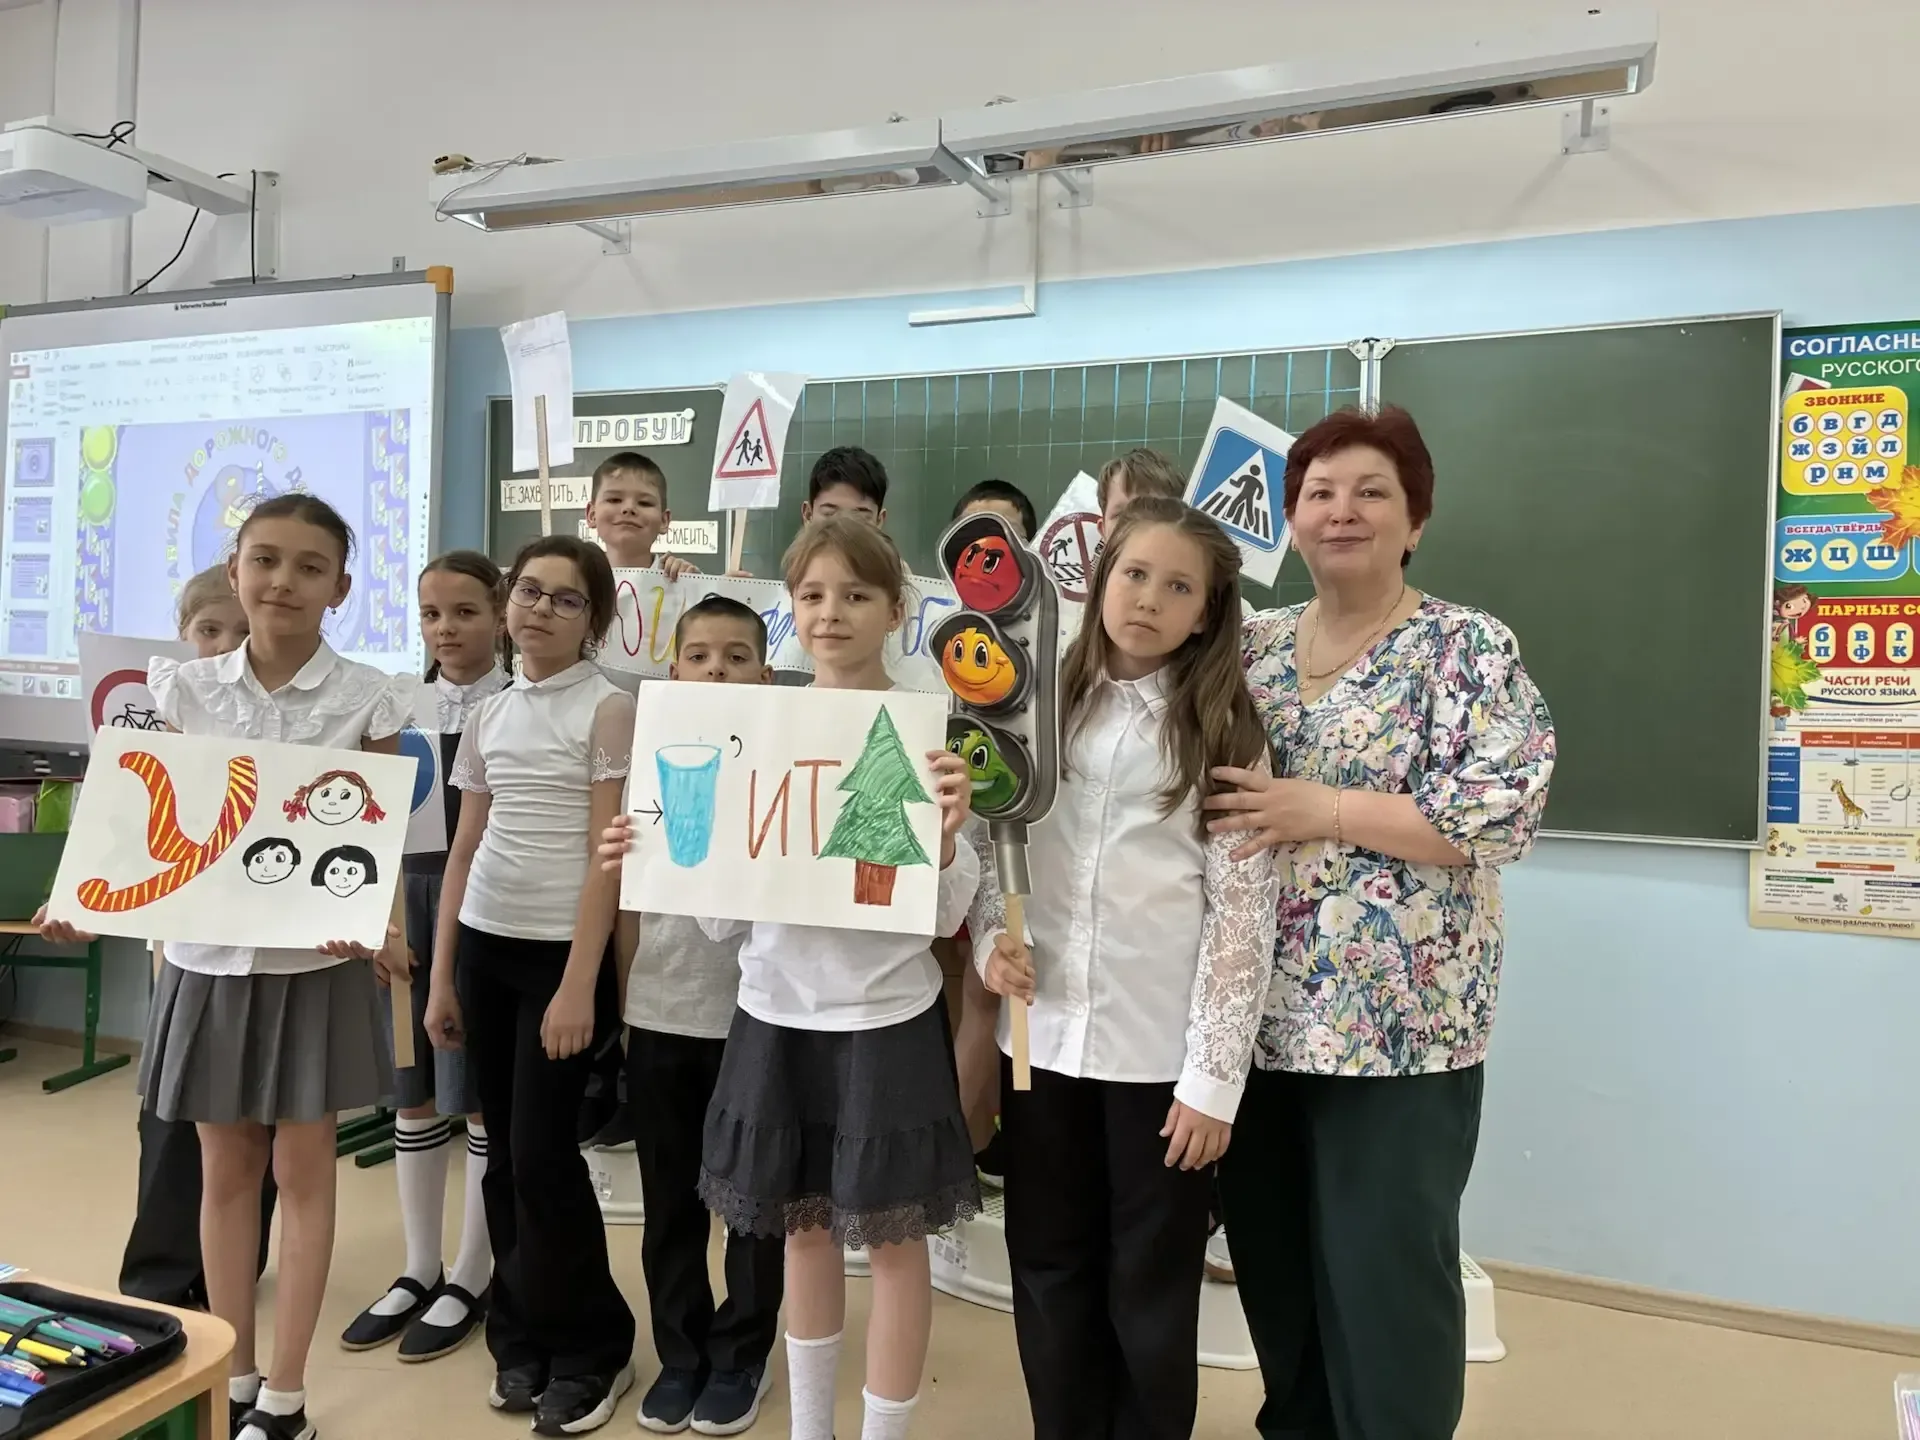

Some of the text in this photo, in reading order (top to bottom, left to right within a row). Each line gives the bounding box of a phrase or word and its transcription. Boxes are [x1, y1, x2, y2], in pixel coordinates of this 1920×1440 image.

[1804, 393, 1885, 407] ЗВОНКИЕ
[577, 412, 687, 444] ПРОБУЙ
[1793, 413, 1898, 433] б в г д
[1791, 438, 1898, 457] ж з й л
[1809, 465, 1885, 483] р н м
[1787, 525, 1832, 533] ВСЕГДА
[1817, 604, 1920, 616] ПАРНЫЕ С
[1815, 626, 1907, 642] б в г
[1815, 644, 1907, 660] п ф к
[1824, 675, 1911, 687] ЧАСТИ РЕЧИ
[1821, 688, 1917, 697] РУССКОГО ЯЗЫКА
[78, 751, 258, 912] У
